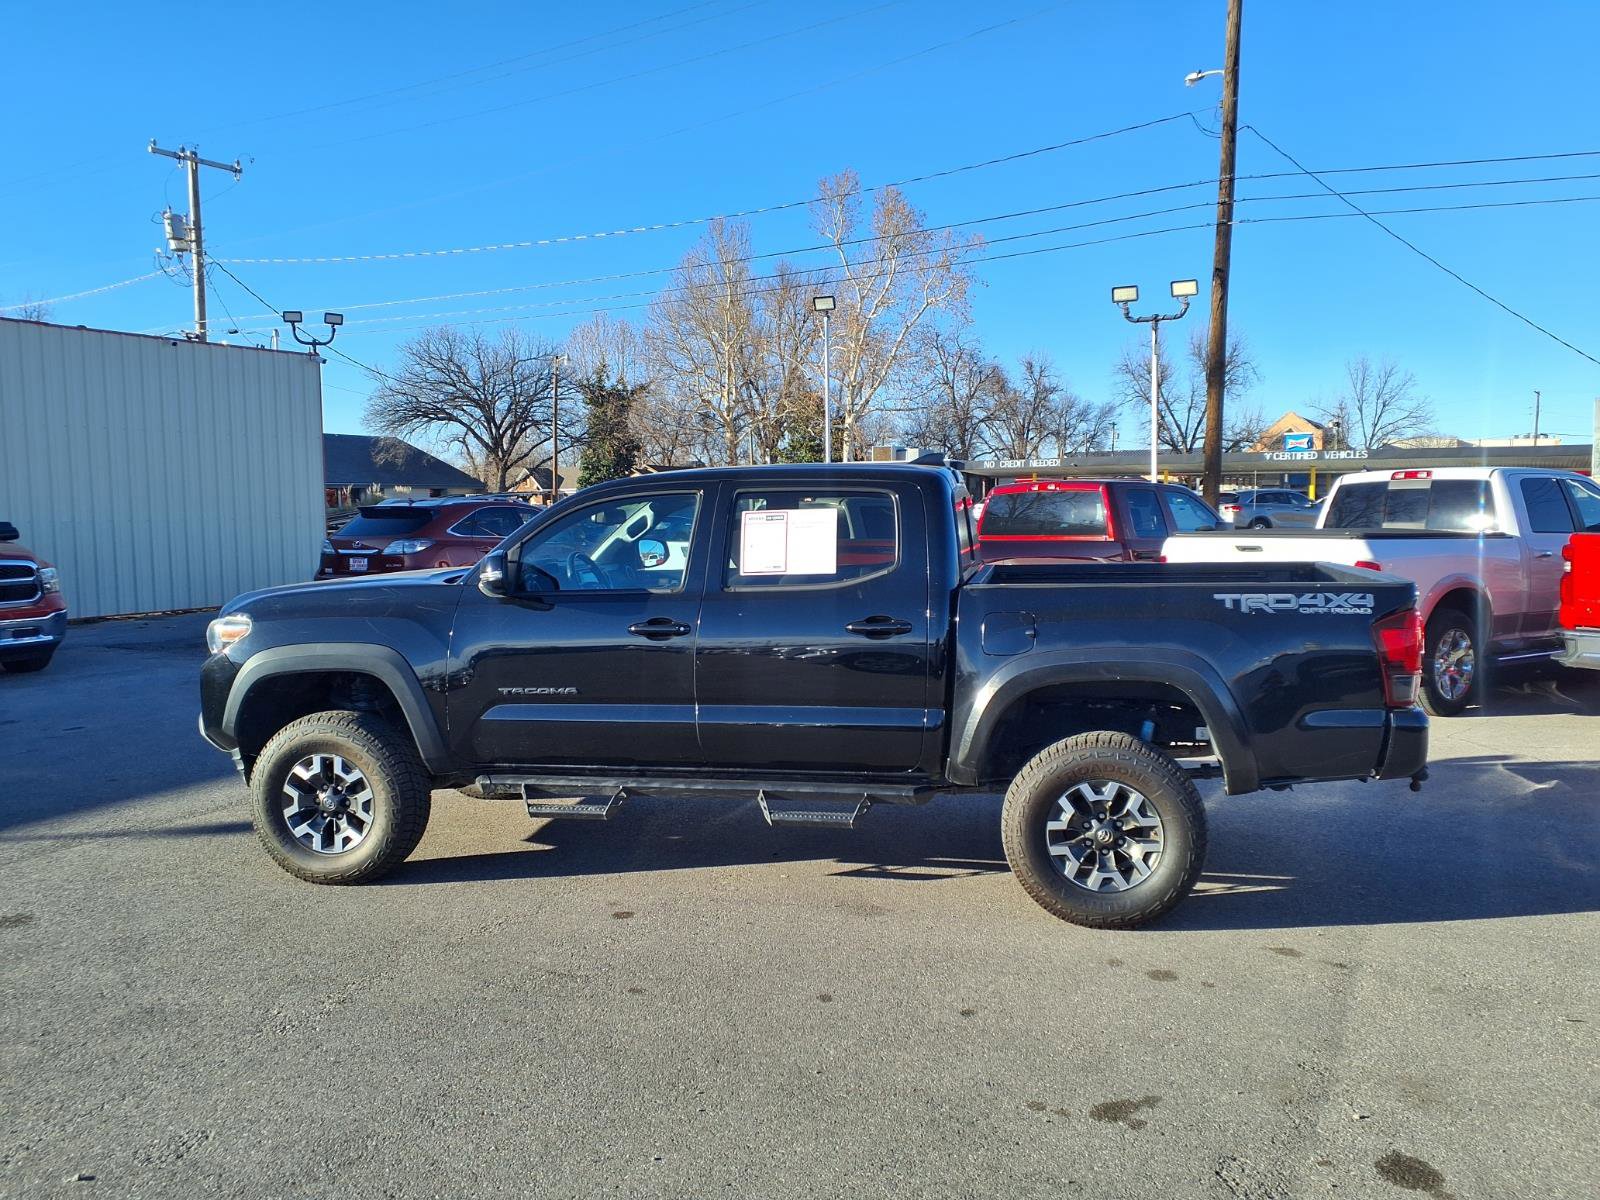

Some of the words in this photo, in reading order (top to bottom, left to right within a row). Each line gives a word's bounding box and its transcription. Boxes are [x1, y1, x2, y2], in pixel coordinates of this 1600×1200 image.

[1273, 452, 1318, 460] CERTIFIED
[1324, 450, 1368, 459] VEHICLES
[1000, 460, 1025, 468] CREDIT
[1213, 593, 1299, 614] TRD
[1330, 607, 1373, 615] ROAD
[498, 687, 578, 695] TACOMA
